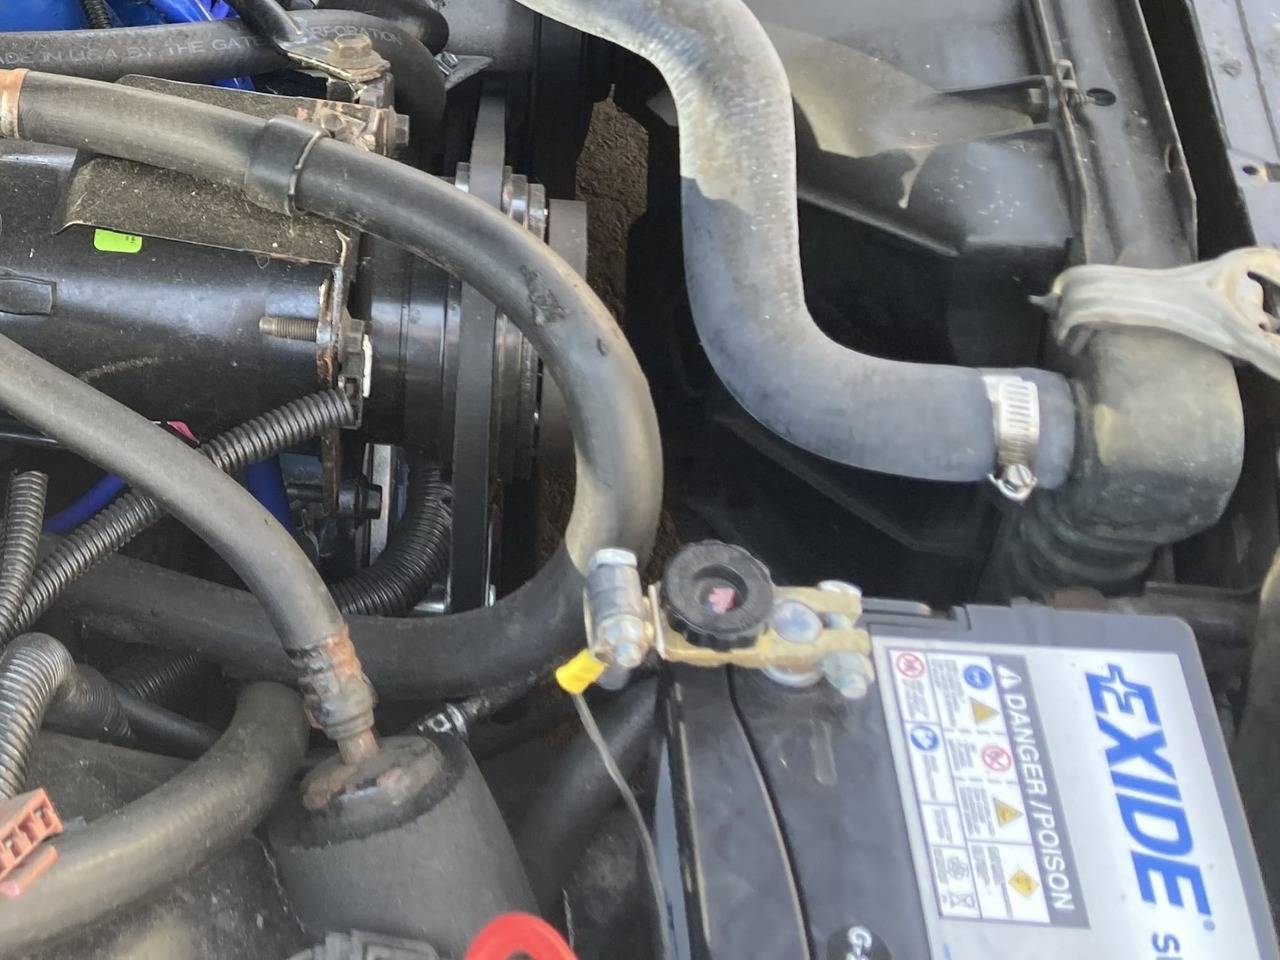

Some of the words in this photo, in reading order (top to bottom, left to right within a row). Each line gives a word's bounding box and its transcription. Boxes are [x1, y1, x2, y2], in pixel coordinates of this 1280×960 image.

[165, 40, 206, 56] THE
[212, 36, 266, 51] GATE
[1004, 694, 1048, 795] DANGER
[1085, 664, 1212, 916] EXIDE
[1151, 932, 1183, 959] S
